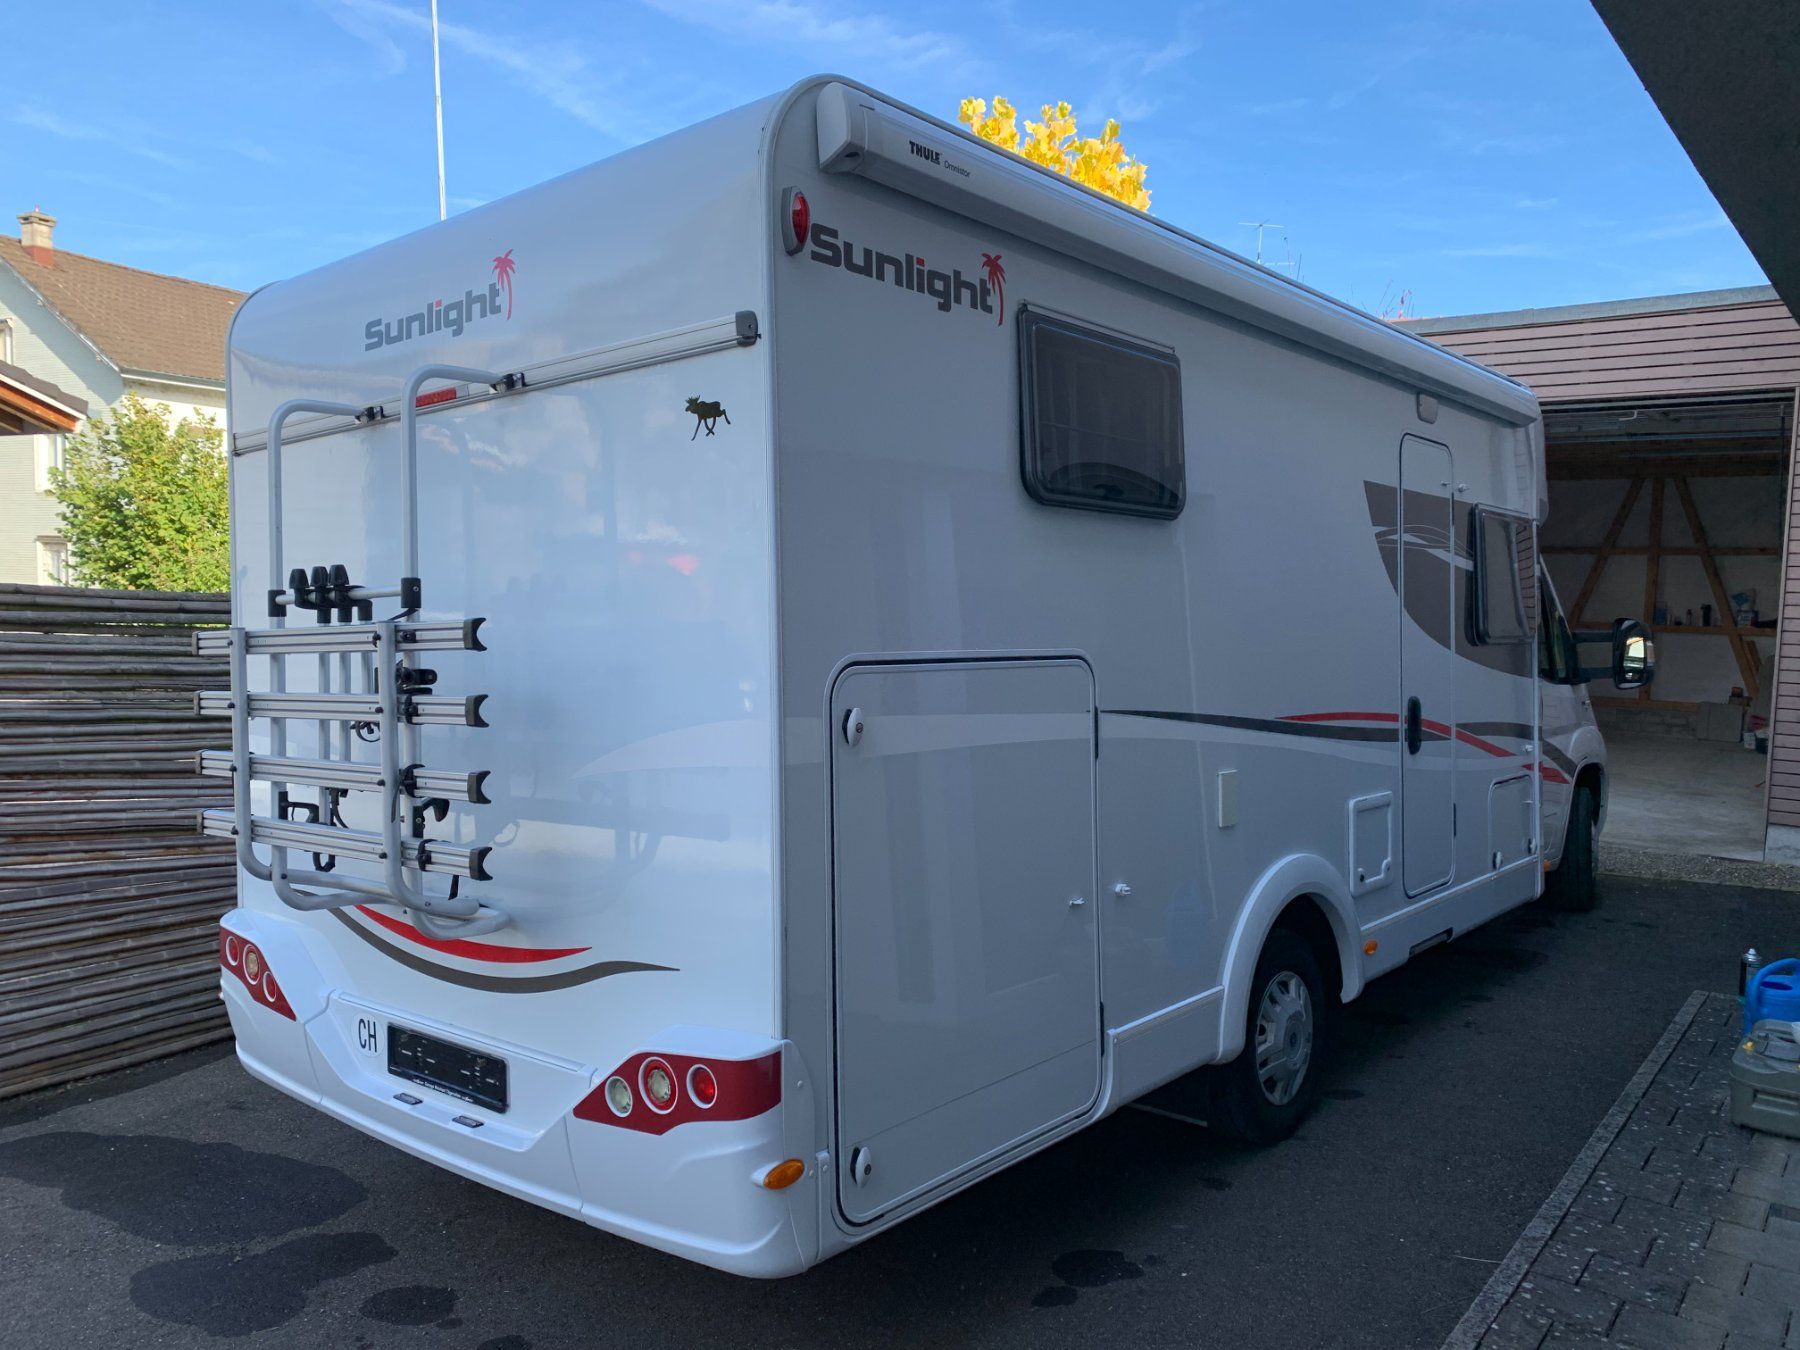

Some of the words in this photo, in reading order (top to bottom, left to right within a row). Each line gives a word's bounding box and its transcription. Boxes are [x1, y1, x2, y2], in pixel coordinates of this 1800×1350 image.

[909, 140, 941, 163] THULE
[944, 160, 971, 178] Omnistor
[810, 222, 993, 314] Sunlight
[365, 282, 502, 352] Sunlight
[358, 1018, 377, 1053] CH
